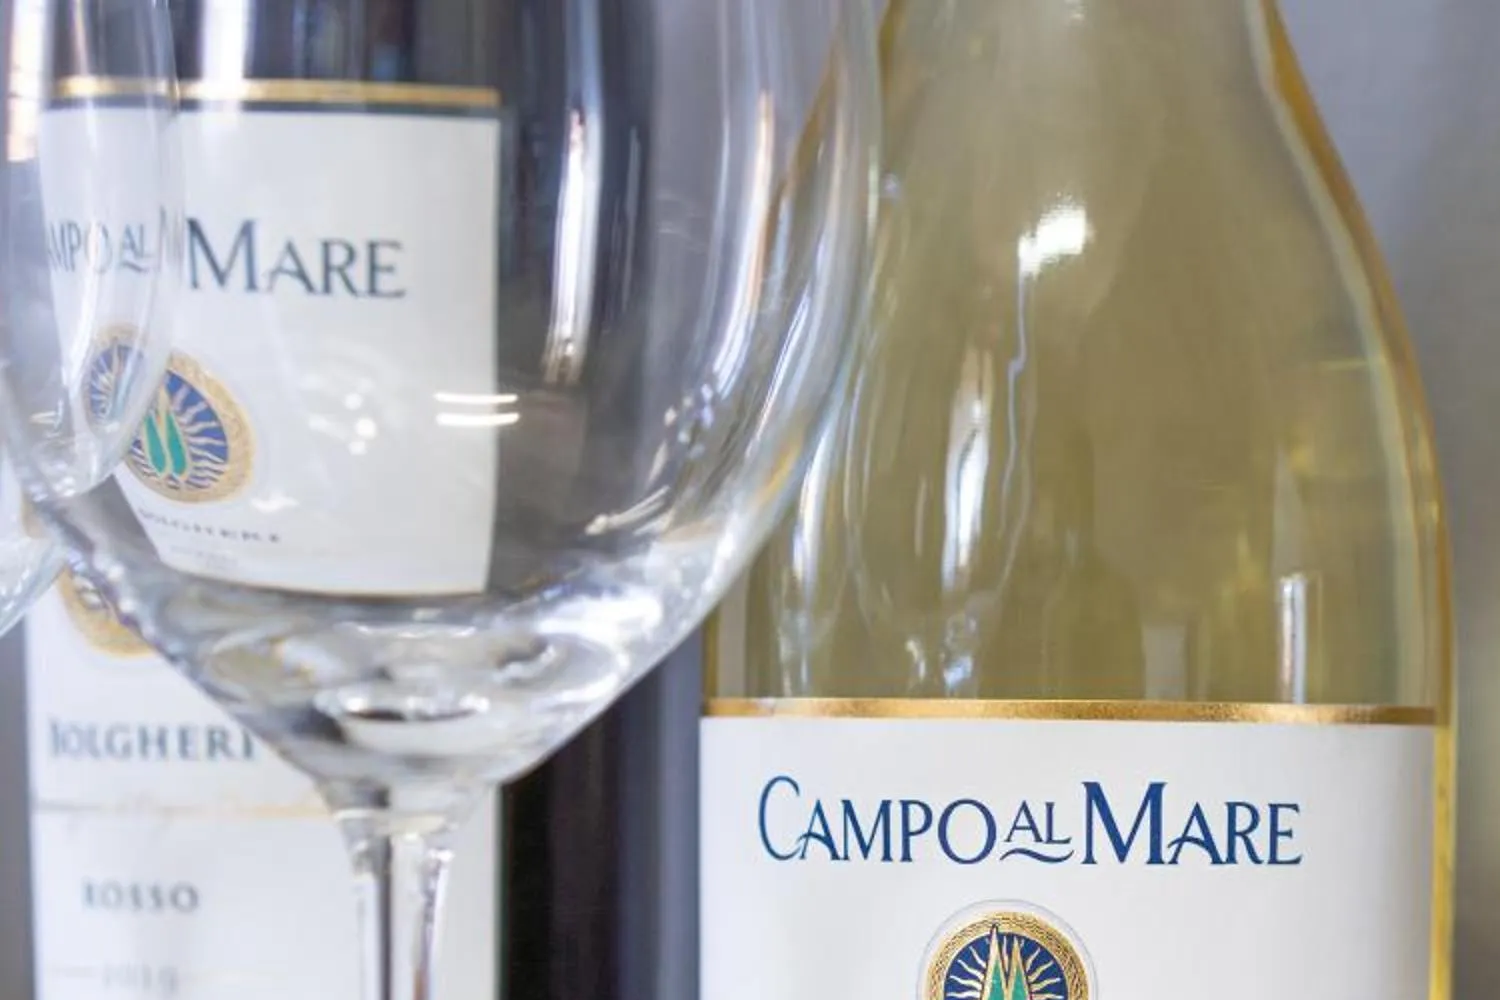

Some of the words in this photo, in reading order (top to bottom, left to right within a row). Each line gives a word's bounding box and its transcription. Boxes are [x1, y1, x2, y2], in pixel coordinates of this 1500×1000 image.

[186, 217, 406, 299] MARE
[758, 775, 997, 865] CAMPO
[1000, 800, 1073, 864] AL
[1081, 781, 1304, 866] MARE
